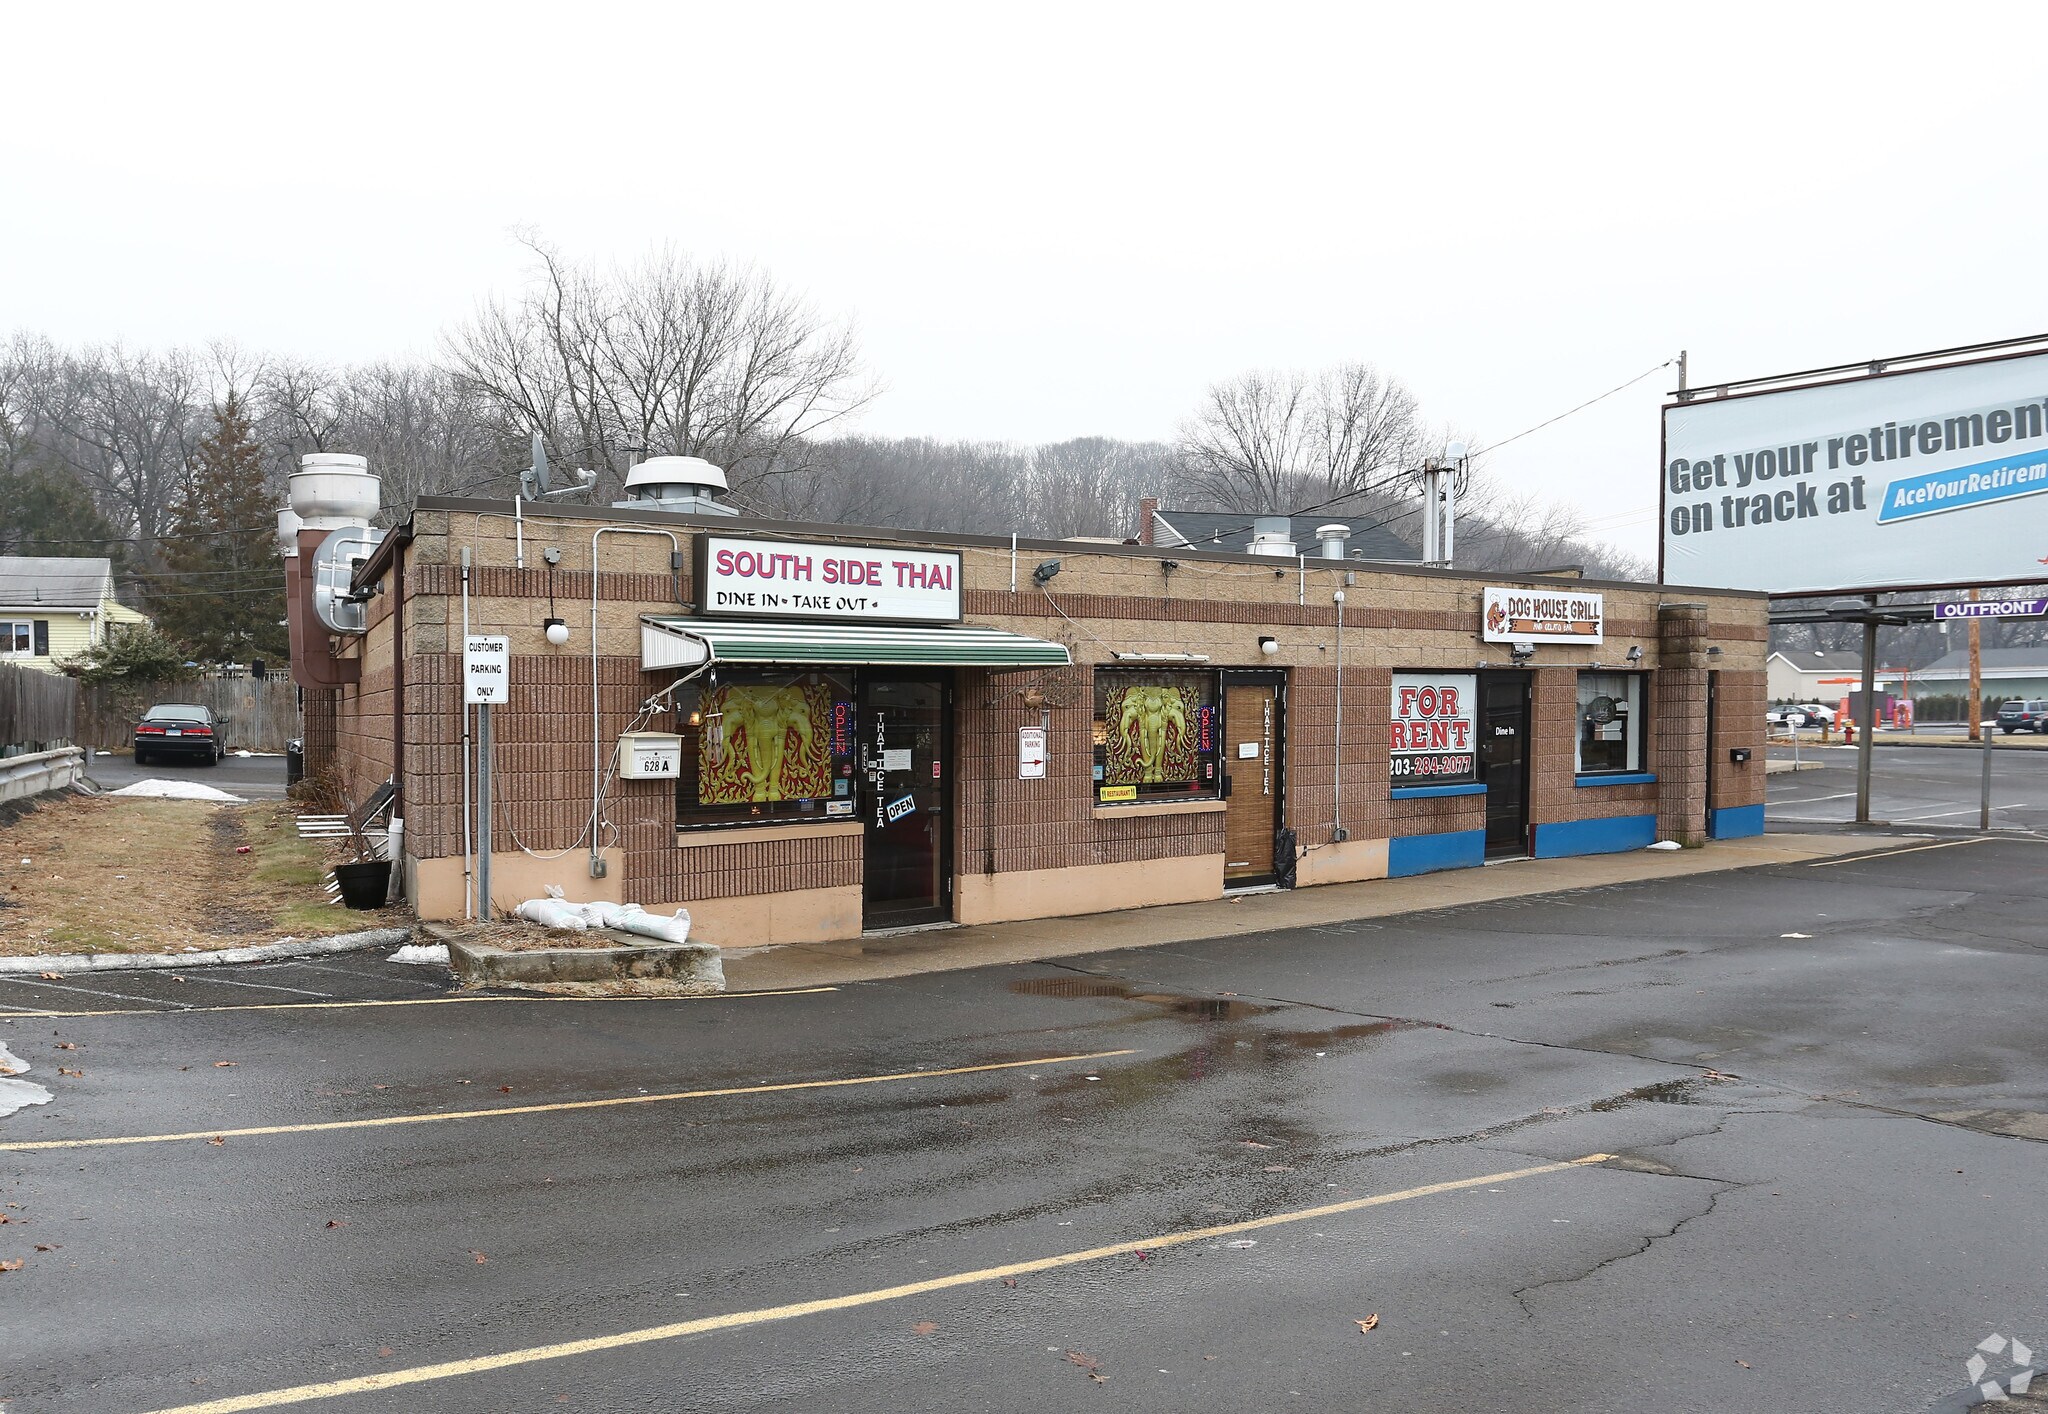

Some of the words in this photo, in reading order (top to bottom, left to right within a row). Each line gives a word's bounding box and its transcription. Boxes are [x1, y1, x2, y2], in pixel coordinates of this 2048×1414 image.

[1669, 453, 1728, 495] Get
[1733, 441, 1818, 489] your
[1670, 501, 1713, 536] on
[1720, 481, 1819, 529] track
[1827, 475, 1867, 515] at
[716, 549, 813, 582] SOUTH
[822, 558, 883, 587] SIDE
[891, 561, 953, 590] THAI
[716, 591, 756, 607] DINE
[762, 593, 779, 607] IN
[792, 595, 832, 610] TAKE
[836, 597, 868, 611] OUT
[1508, 597, 1531, 617] DOG
[1533, 598, 1569, 619] HOUSE
[1570, 600, 1600, 620] GRILL
[1944, 600, 2038, 617] OUTFRONT
[468, 642, 504, 652] CUSTOMER
[470, 664, 502, 674] PARKING
[476, 686, 495, 696] ONLY
[1398, 685, 1459, 719] FOR
[835, 705, 846, 754] OPEN
[876, 712, 885, 753] THAI
[1022, 731, 1043, 739] ADDITIONAL
[1201, 708, 1210, 750] OPEN
[1391, 718, 1471, 752] RENT
[1495, 726, 1508, 736] Dine
[1508, 726, 1515, 736] In
[1024, 740, 1041, 748] PARKING
[644, 760, 660, 772] 628
[661, 760, 670, 772] A
[876, 758, 885, 791] ICE
[1106, 789, 1131, 797] RESTAURANT
[876, 796, 885, 828] TEA
[888, 797, 914, 819] OPEN
